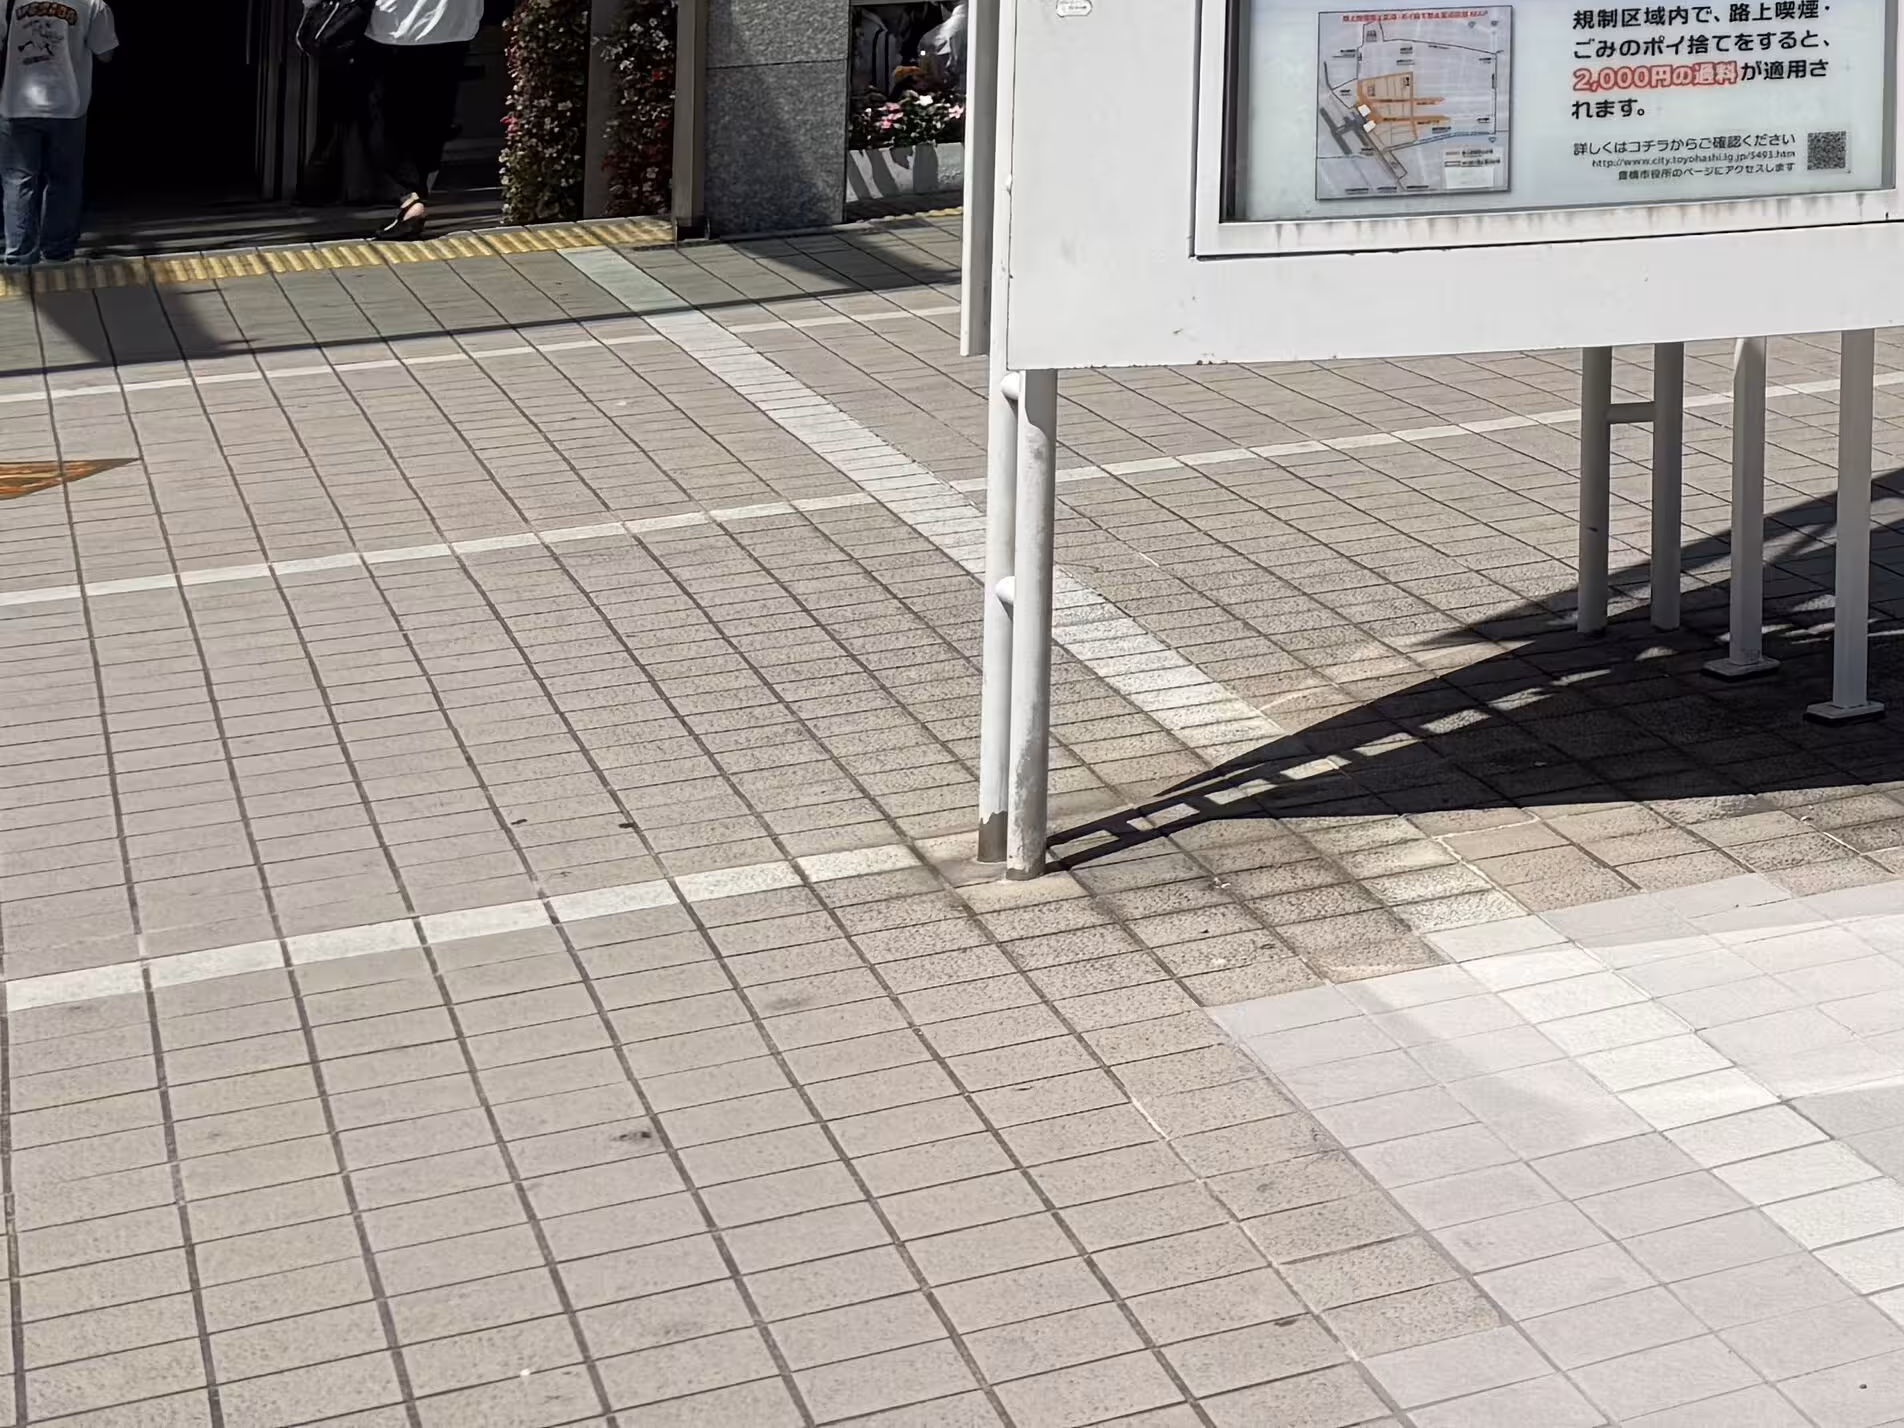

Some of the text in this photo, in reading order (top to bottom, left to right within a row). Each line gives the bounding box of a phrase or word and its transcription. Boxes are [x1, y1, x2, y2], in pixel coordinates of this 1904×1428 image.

[1573, 30, 1831, 60] ごみのポイ捨てをすると、
[1572, 58, 1829, 93] 2,000円の過料が適用さ
[1571, 97, 1645, 120] れます。
[1573, 133, 1796, 157] 詳しくはコチラからご確認ください
[1617, 162, 1795, 181] 豊橋市役所のページにアクセスします
